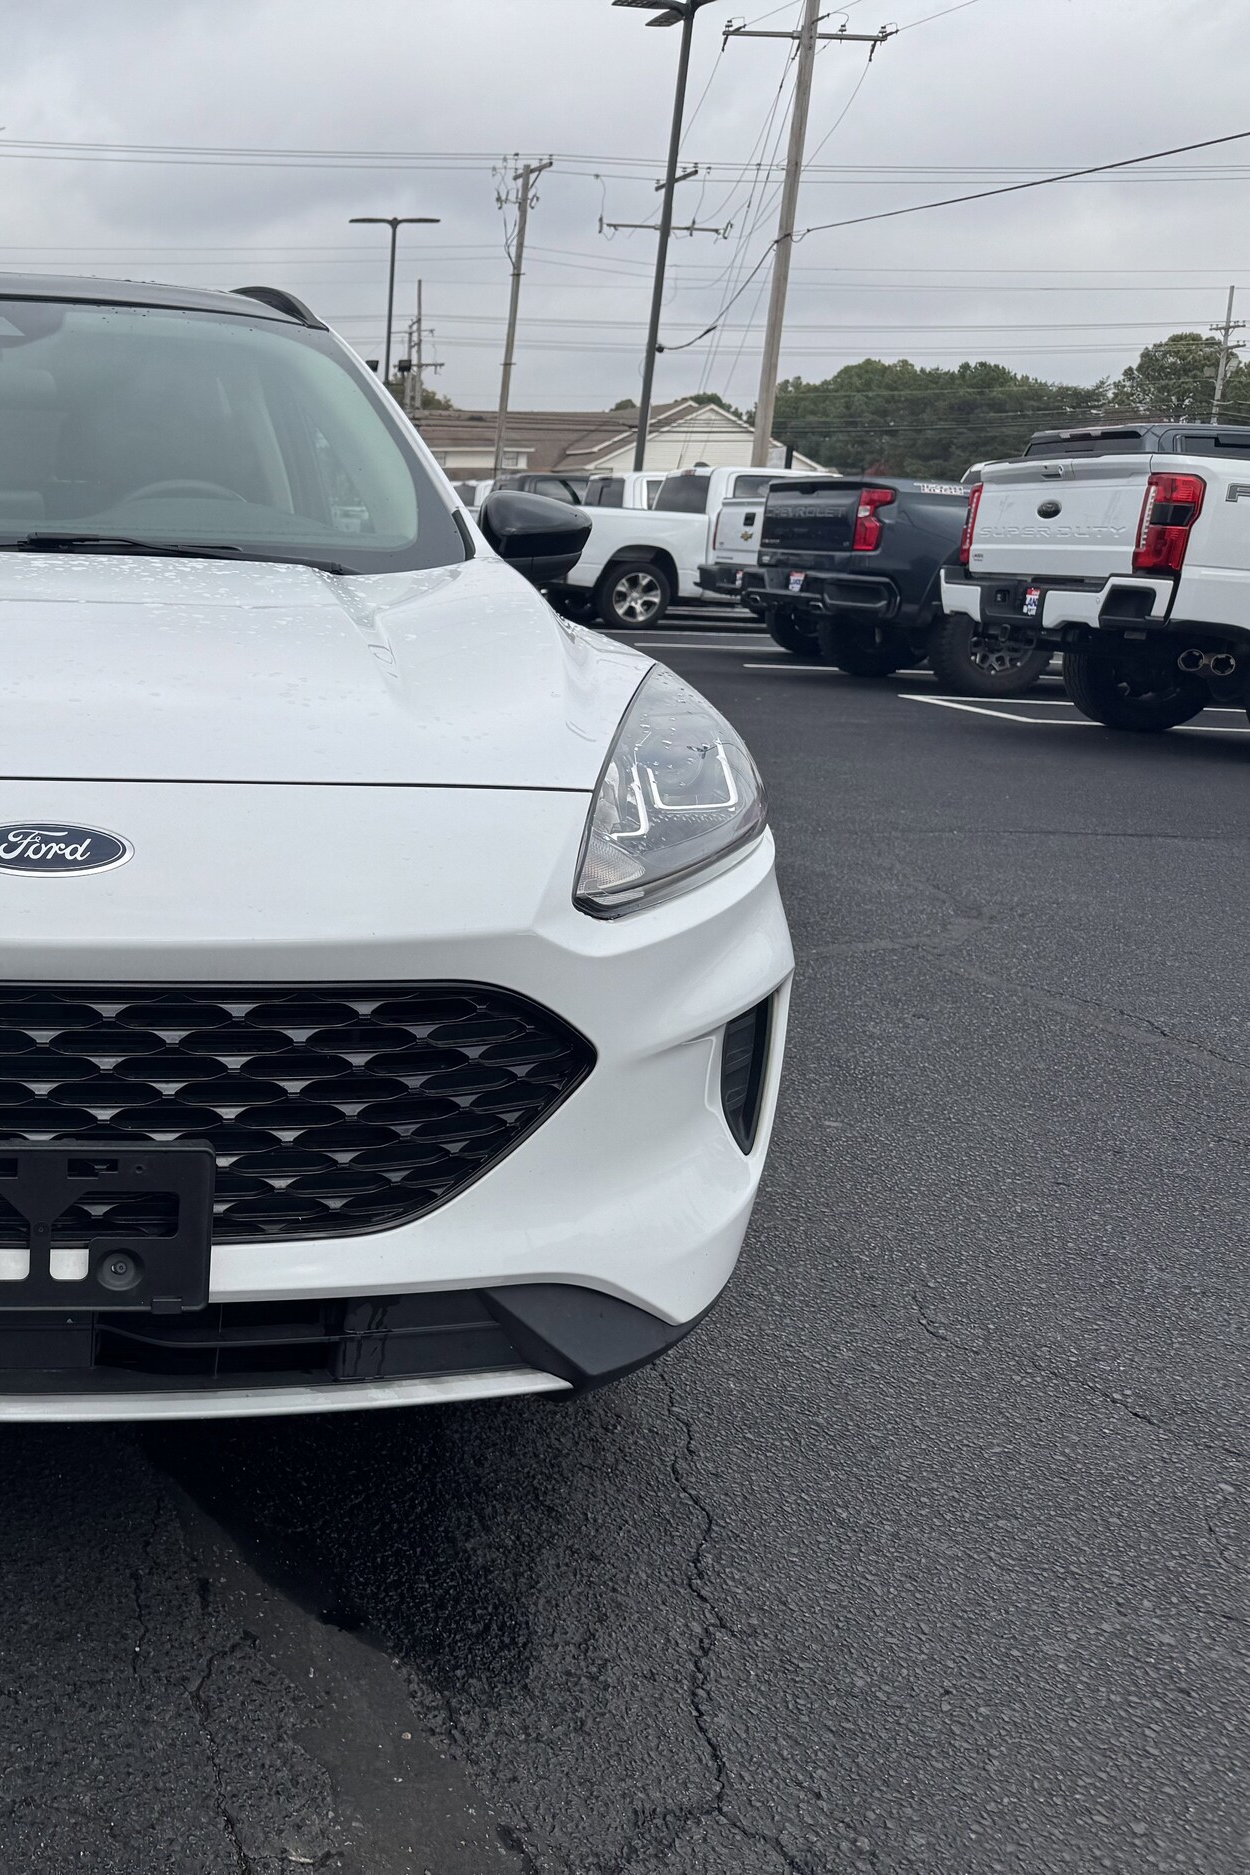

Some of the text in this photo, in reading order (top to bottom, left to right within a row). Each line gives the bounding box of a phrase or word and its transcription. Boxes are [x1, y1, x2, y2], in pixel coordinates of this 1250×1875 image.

[765, 506, 846, 518] CHEVROLET
[980, 525, 1126, 538] SUPER DUTY
